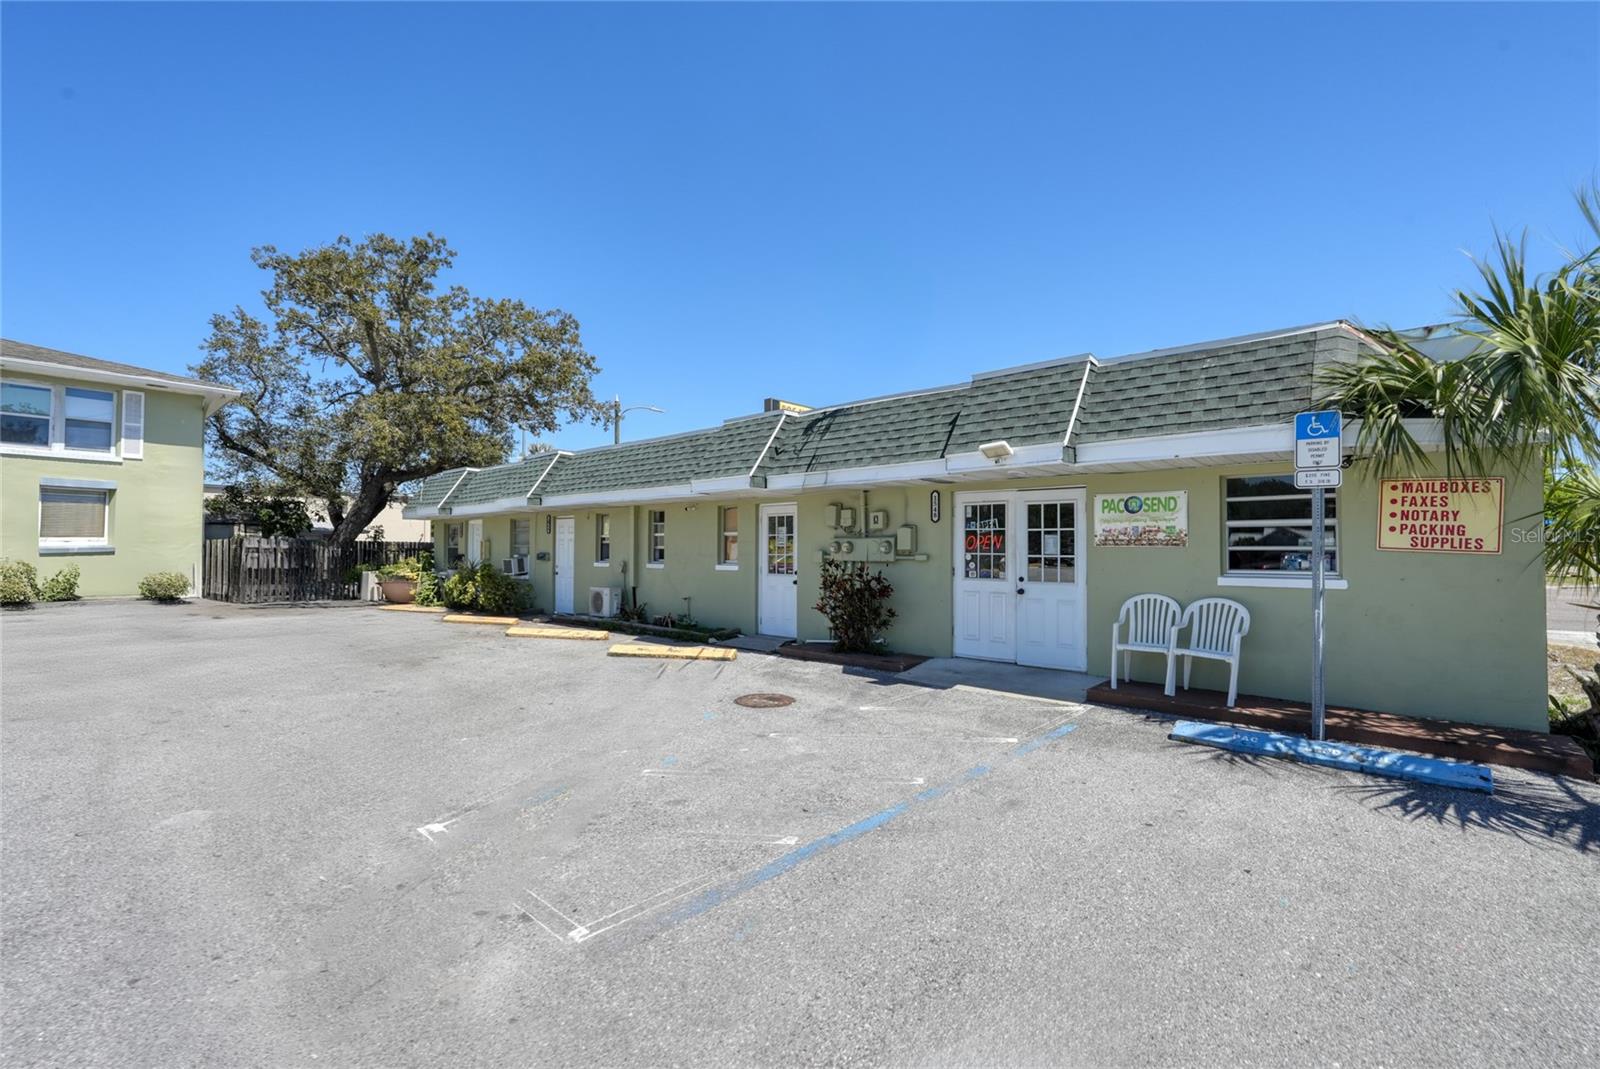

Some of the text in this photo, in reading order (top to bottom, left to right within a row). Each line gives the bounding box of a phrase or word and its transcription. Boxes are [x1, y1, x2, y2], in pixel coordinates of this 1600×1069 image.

[1402, 481, 1492, 494] MAILBOXES
[1101, 499, 1125, 514] PAC
[1143, 496, 1178, 513] SEND
[1401, 496, 1449, 508] FAXES
[1400, 510, 1460, 522] NOTARY
[1399, 524, 1466, 536] PACKING
[966, 535, 1003, 550] OPEN
[1410, 536, 1484, 550] SUPPLIES
